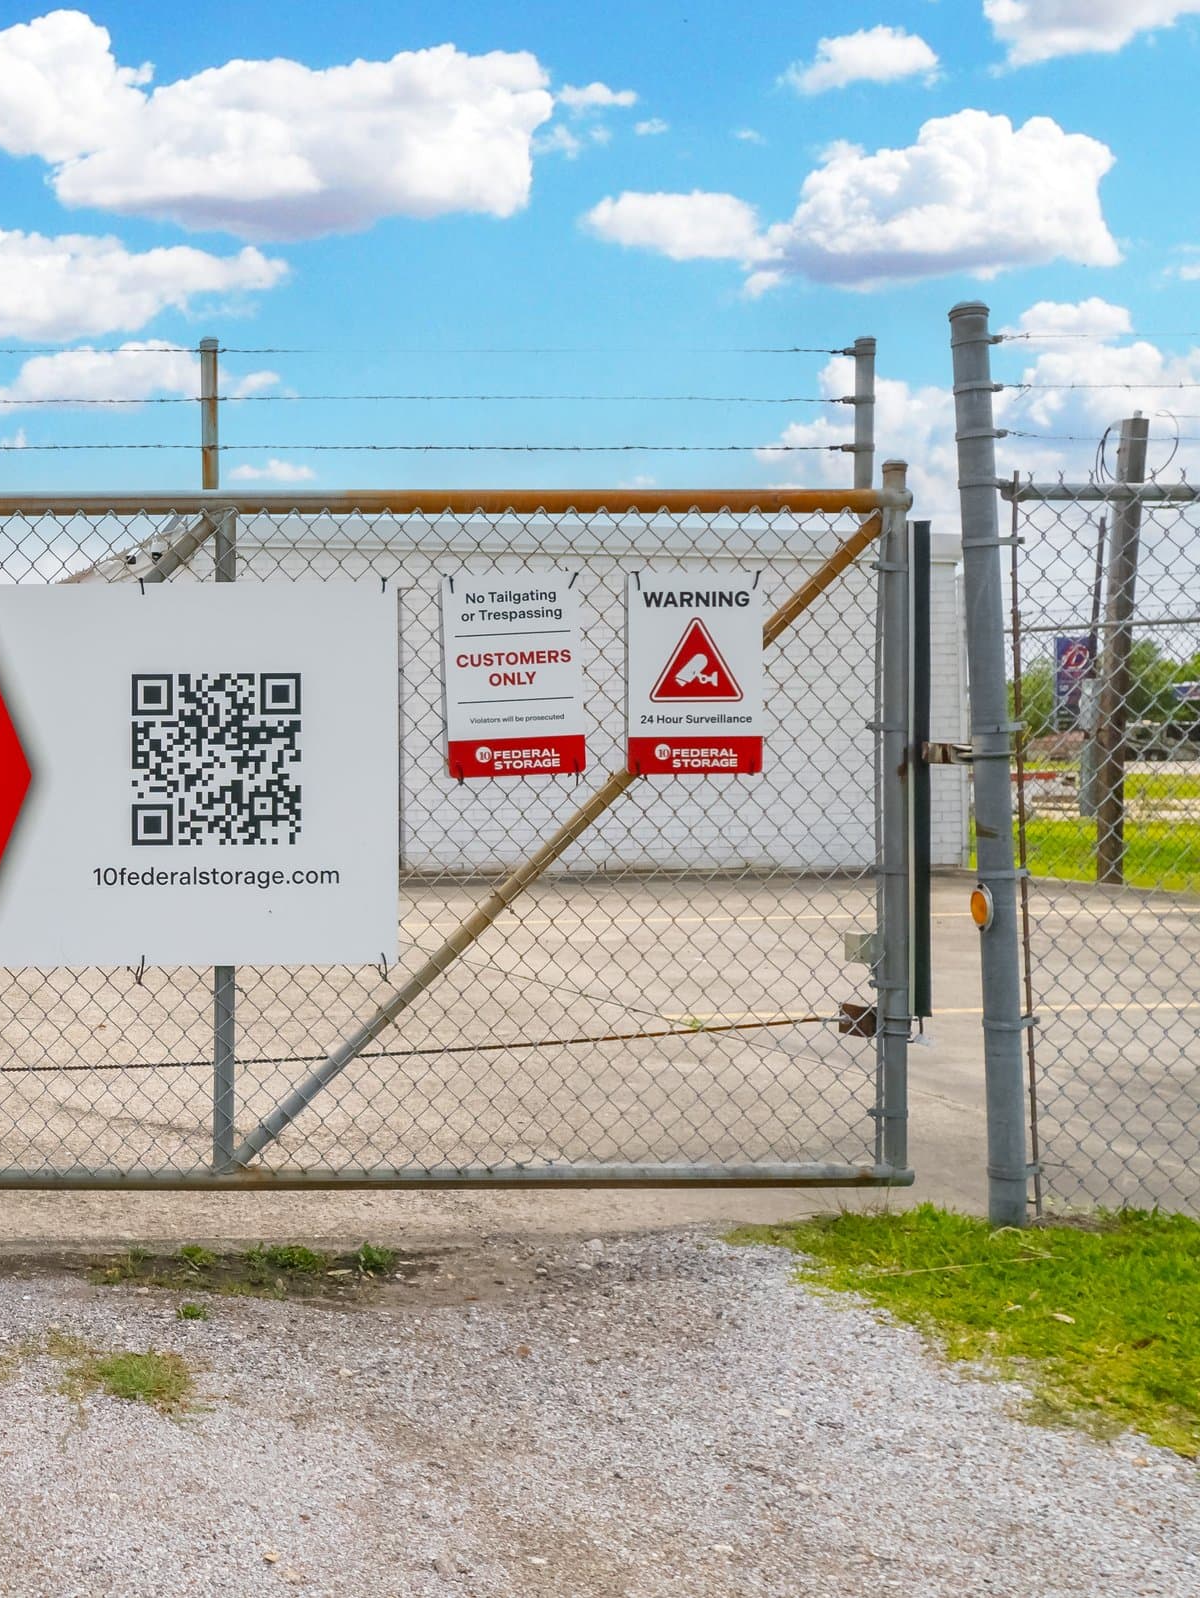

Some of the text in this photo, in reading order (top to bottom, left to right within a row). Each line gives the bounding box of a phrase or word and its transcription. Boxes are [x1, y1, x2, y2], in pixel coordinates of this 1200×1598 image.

[465, 589, 557, 605] No Tailgating
[643, 591, 751, 608] WARNING
[461, 606, 563, 622] or Trespassing
[456, 649, 572, 669] CUSTOMERS
[488, 671, 537, 687] ONLY
[470, 713, 565, 725] Violators will be prosecuted
[640, 714, 753, 724] 24 Hour Surveillance
[479, 748, 560, 761] 10 FEDERAL
[672, 748, 738, 758] FEDERAL
[494, 758, 561, 770] STORAGE
[672, 758, 738, 768] STORAGE
[92, 866, 341, 889] 10federalstorage.com
